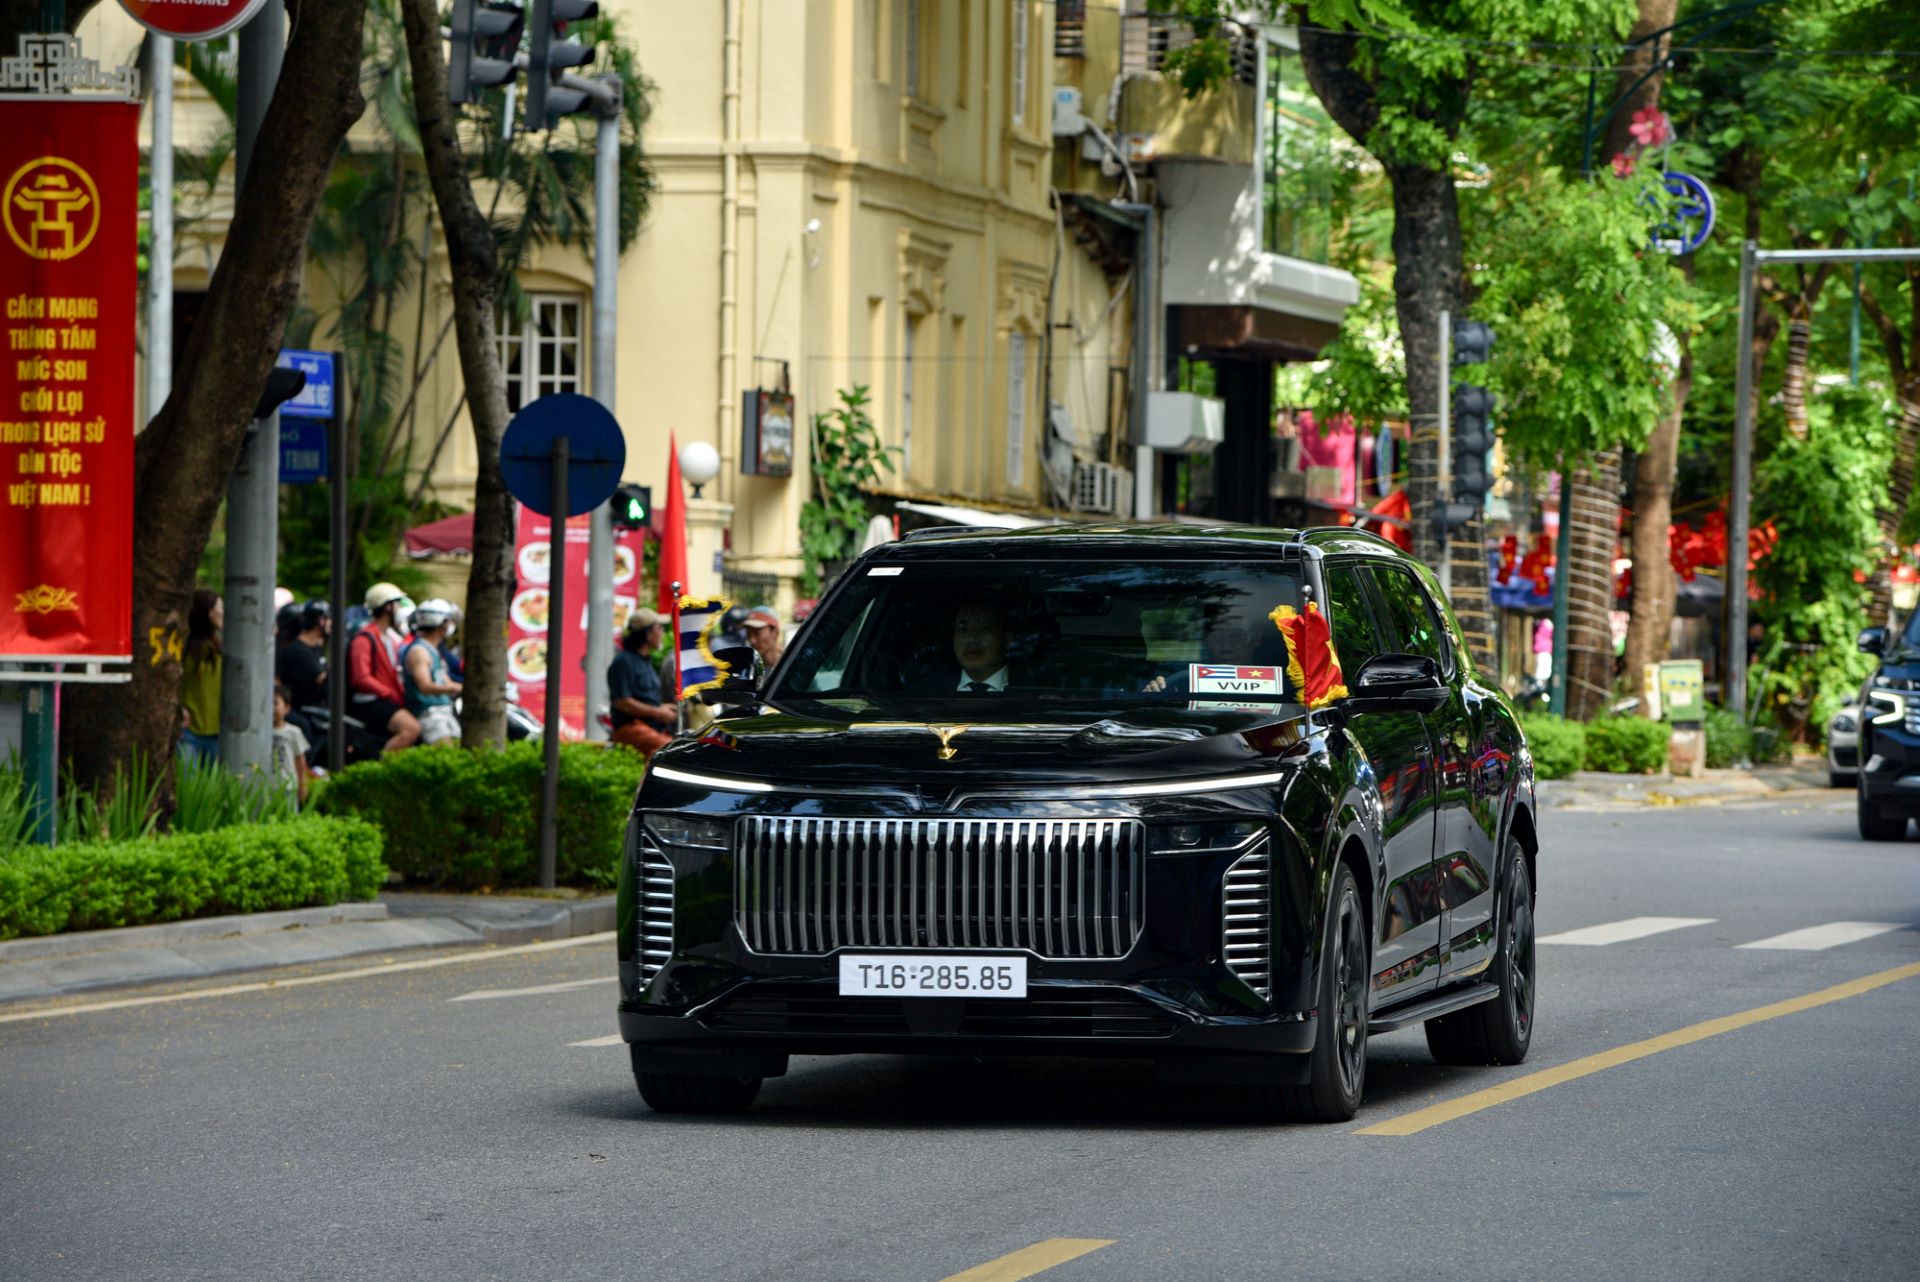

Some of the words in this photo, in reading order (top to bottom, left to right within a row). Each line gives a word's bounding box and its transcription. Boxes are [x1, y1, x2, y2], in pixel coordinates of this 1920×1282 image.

[7, 294, 45, 319] CÁCH
[49, 297, 98, 322] MẠNG
[9, 325, 56, 350] THÁNG
[60, 324, 96, 350] TÁM
[54, 359, 87, 381] SON
[57, 390, 83, 416] LỌI
[44, 421, 81, 447] LỊCH
[85, 416, 106, 443] SỬ
[49, 448, 82, 478] TỘC
[9, 480, 37, 509] VIỆT
[39, 483, 80, 505] NAM
[1217, 681, 1261, 691] VVIP
